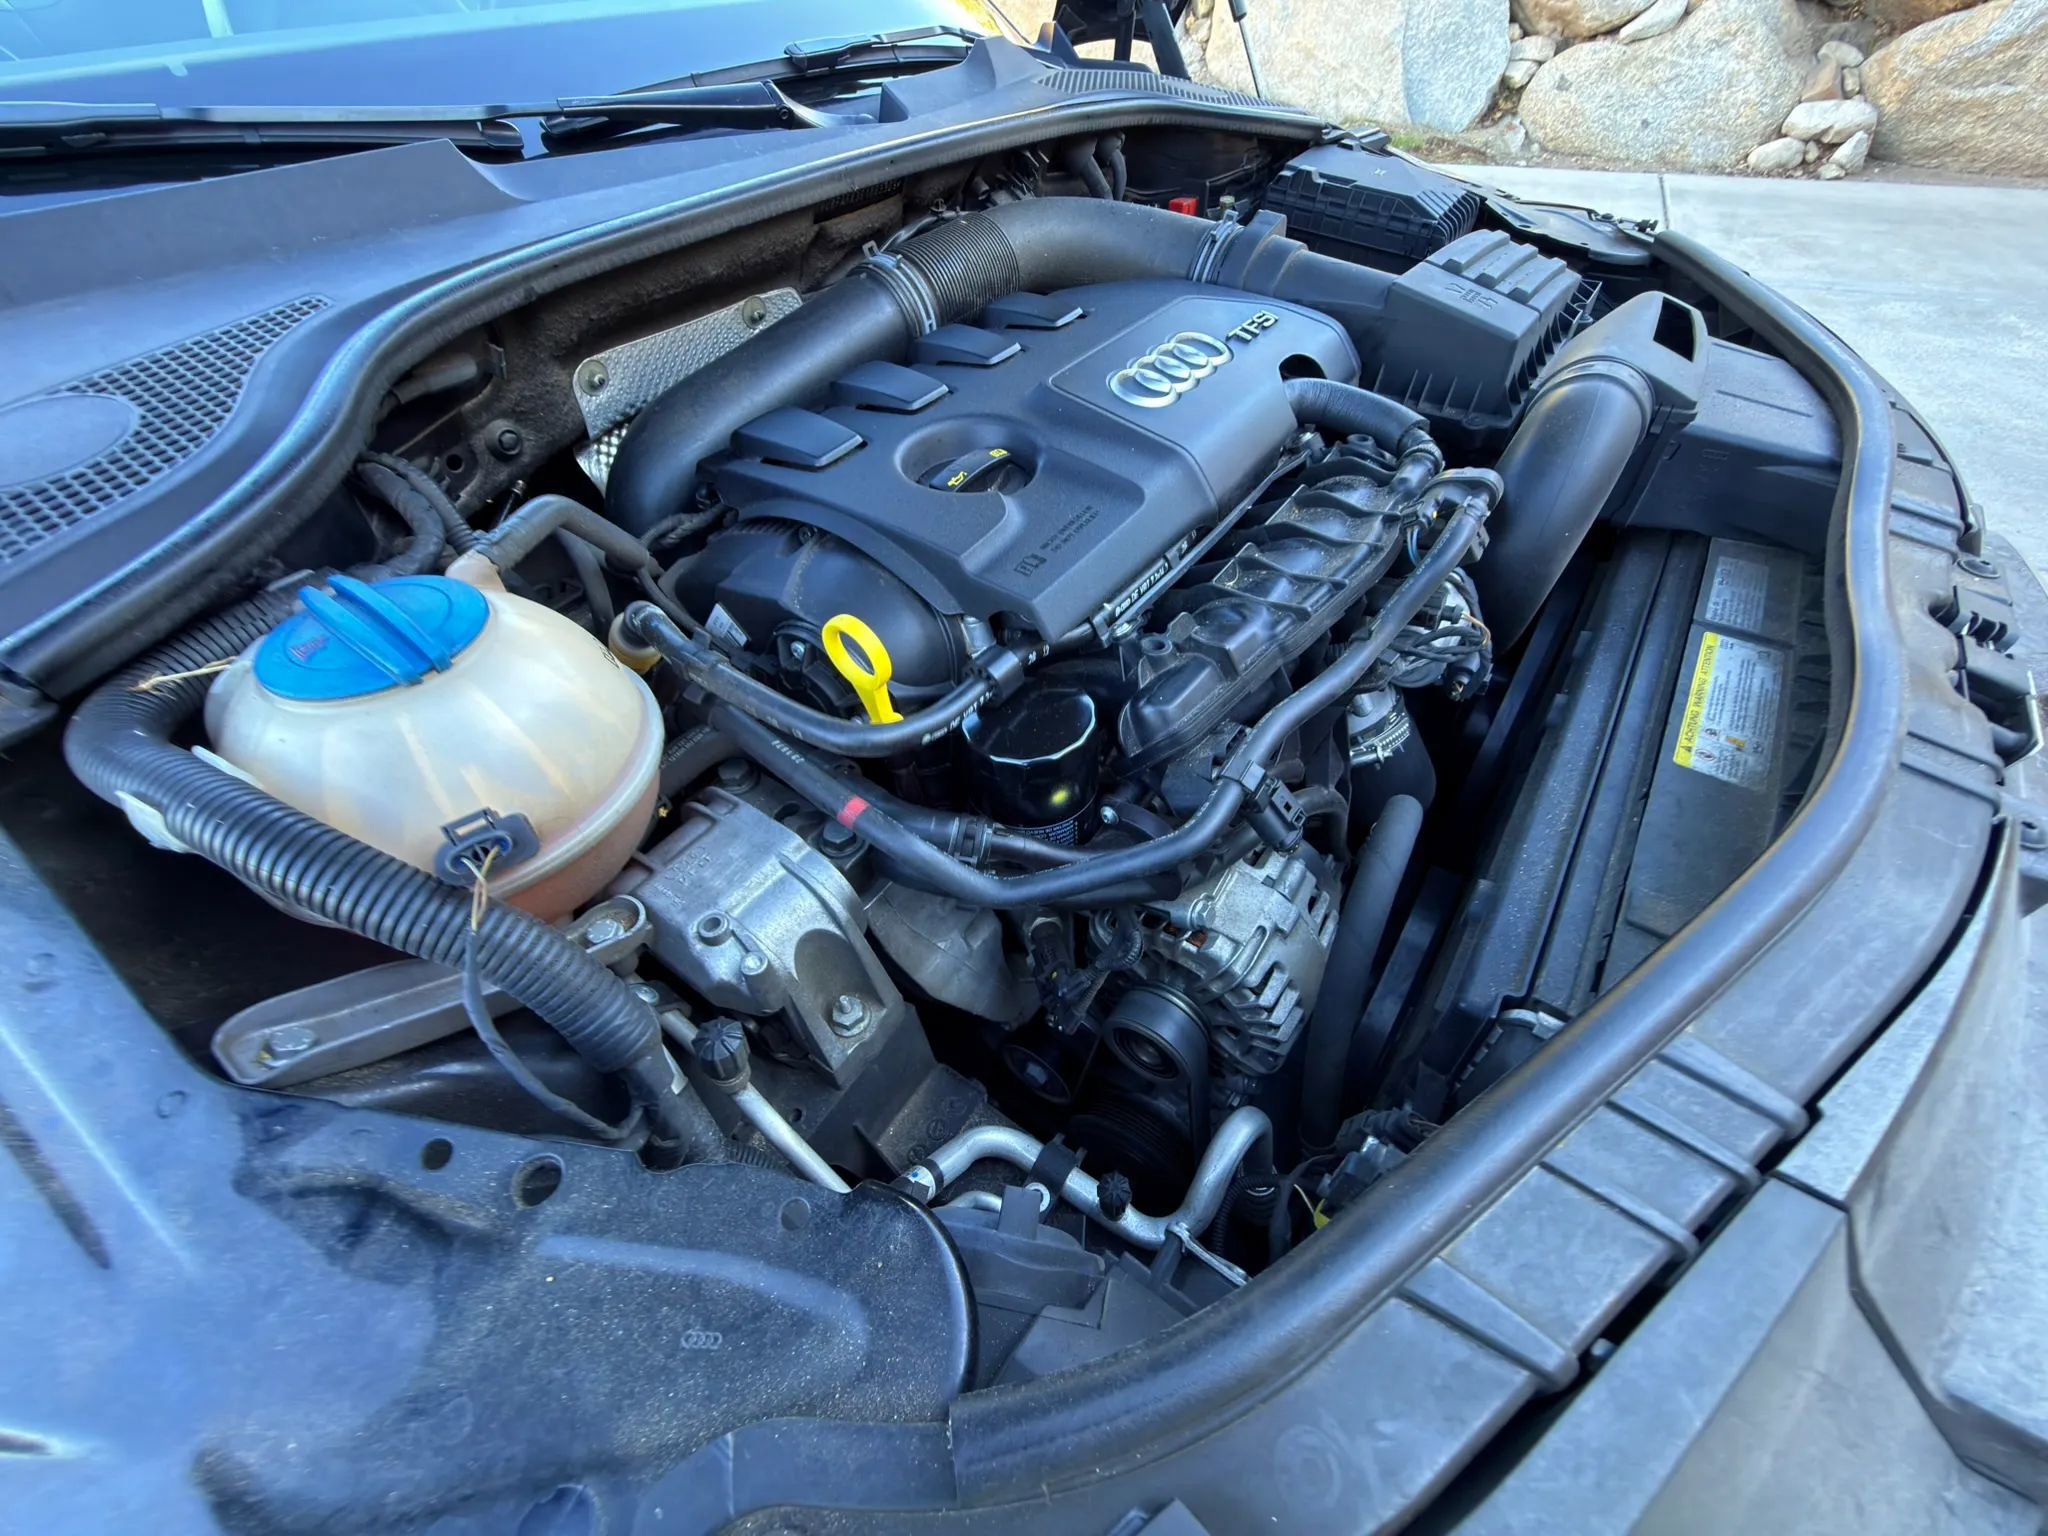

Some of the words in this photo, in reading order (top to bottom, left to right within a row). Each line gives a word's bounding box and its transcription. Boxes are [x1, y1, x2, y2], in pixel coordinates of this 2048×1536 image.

[1226, 309, 1279, 342] TFSI
[1700, 644, 1715, 675] ATTENTION
[1692, 676, 1709, 708] WARNING
[1684, 710, 1701, 744] ACHTUNG
